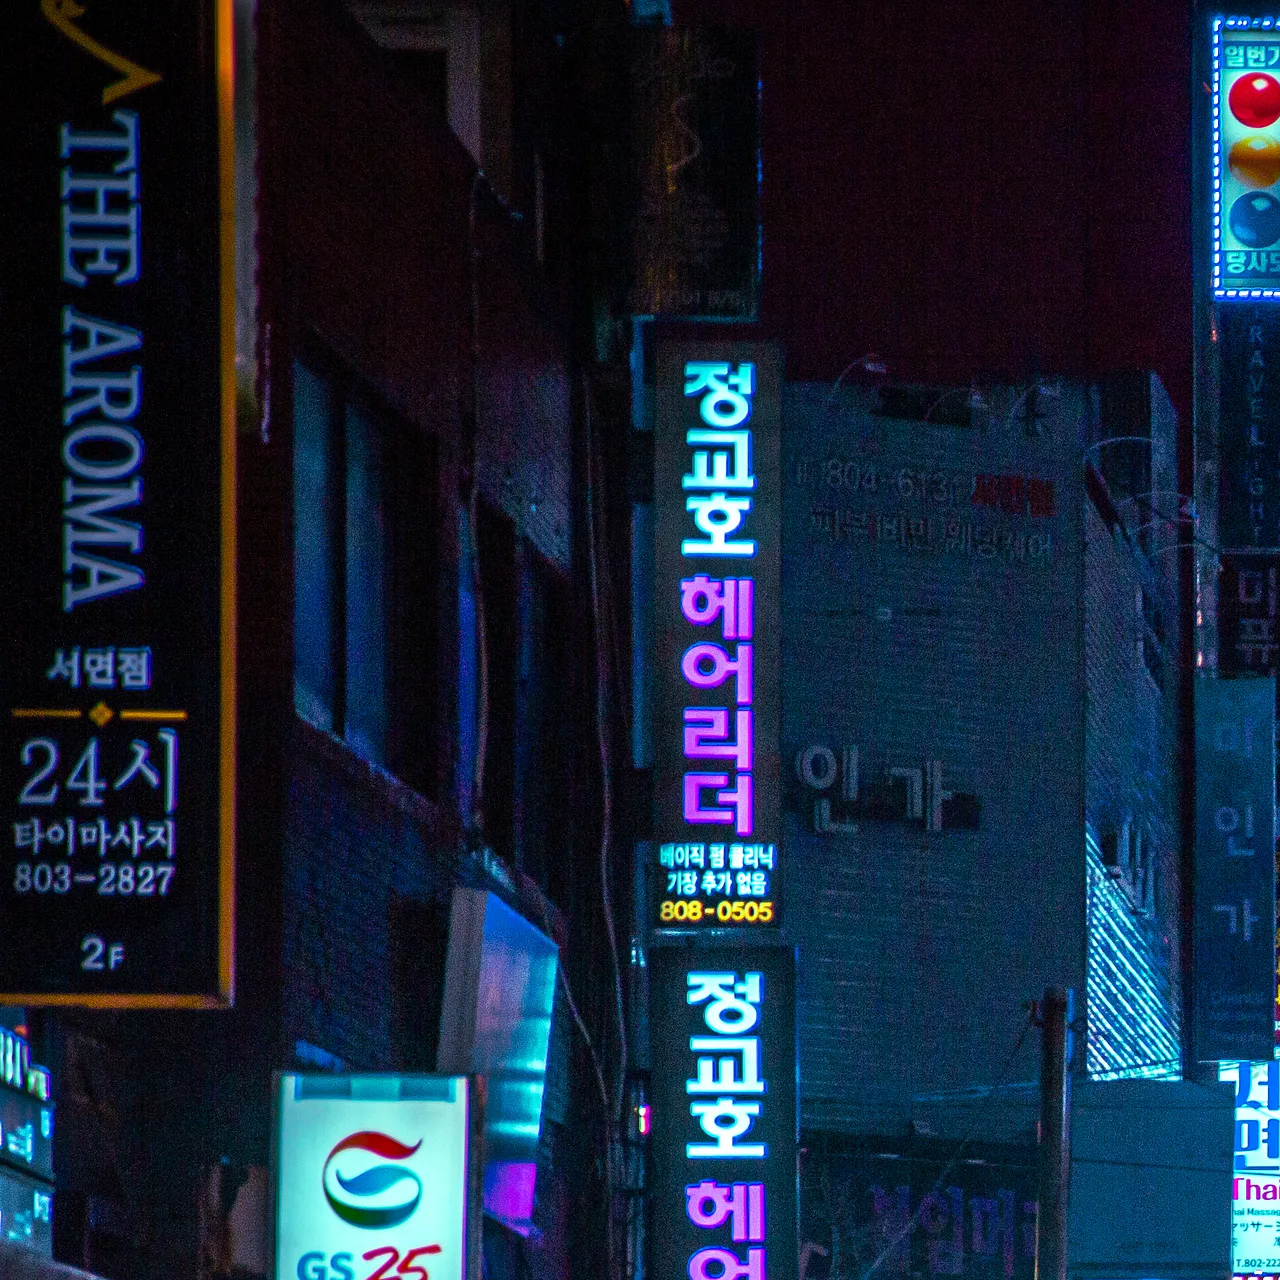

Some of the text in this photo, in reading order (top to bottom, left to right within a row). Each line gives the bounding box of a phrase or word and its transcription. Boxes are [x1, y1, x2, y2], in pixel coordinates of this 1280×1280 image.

[60, 108, 144, 614] THE AROMA
[47, 646, 151, 688] 서면점
[680, 574, 754, 836] 헤어리더
[18, 728, 177, 813] 24시
[12, 817, 176, 857] 타이마사지
[13, 861, 176, 896] 803-2827
[660, 900, 773, 922] 808-0505
[80, 934, 125, 971] 2F
